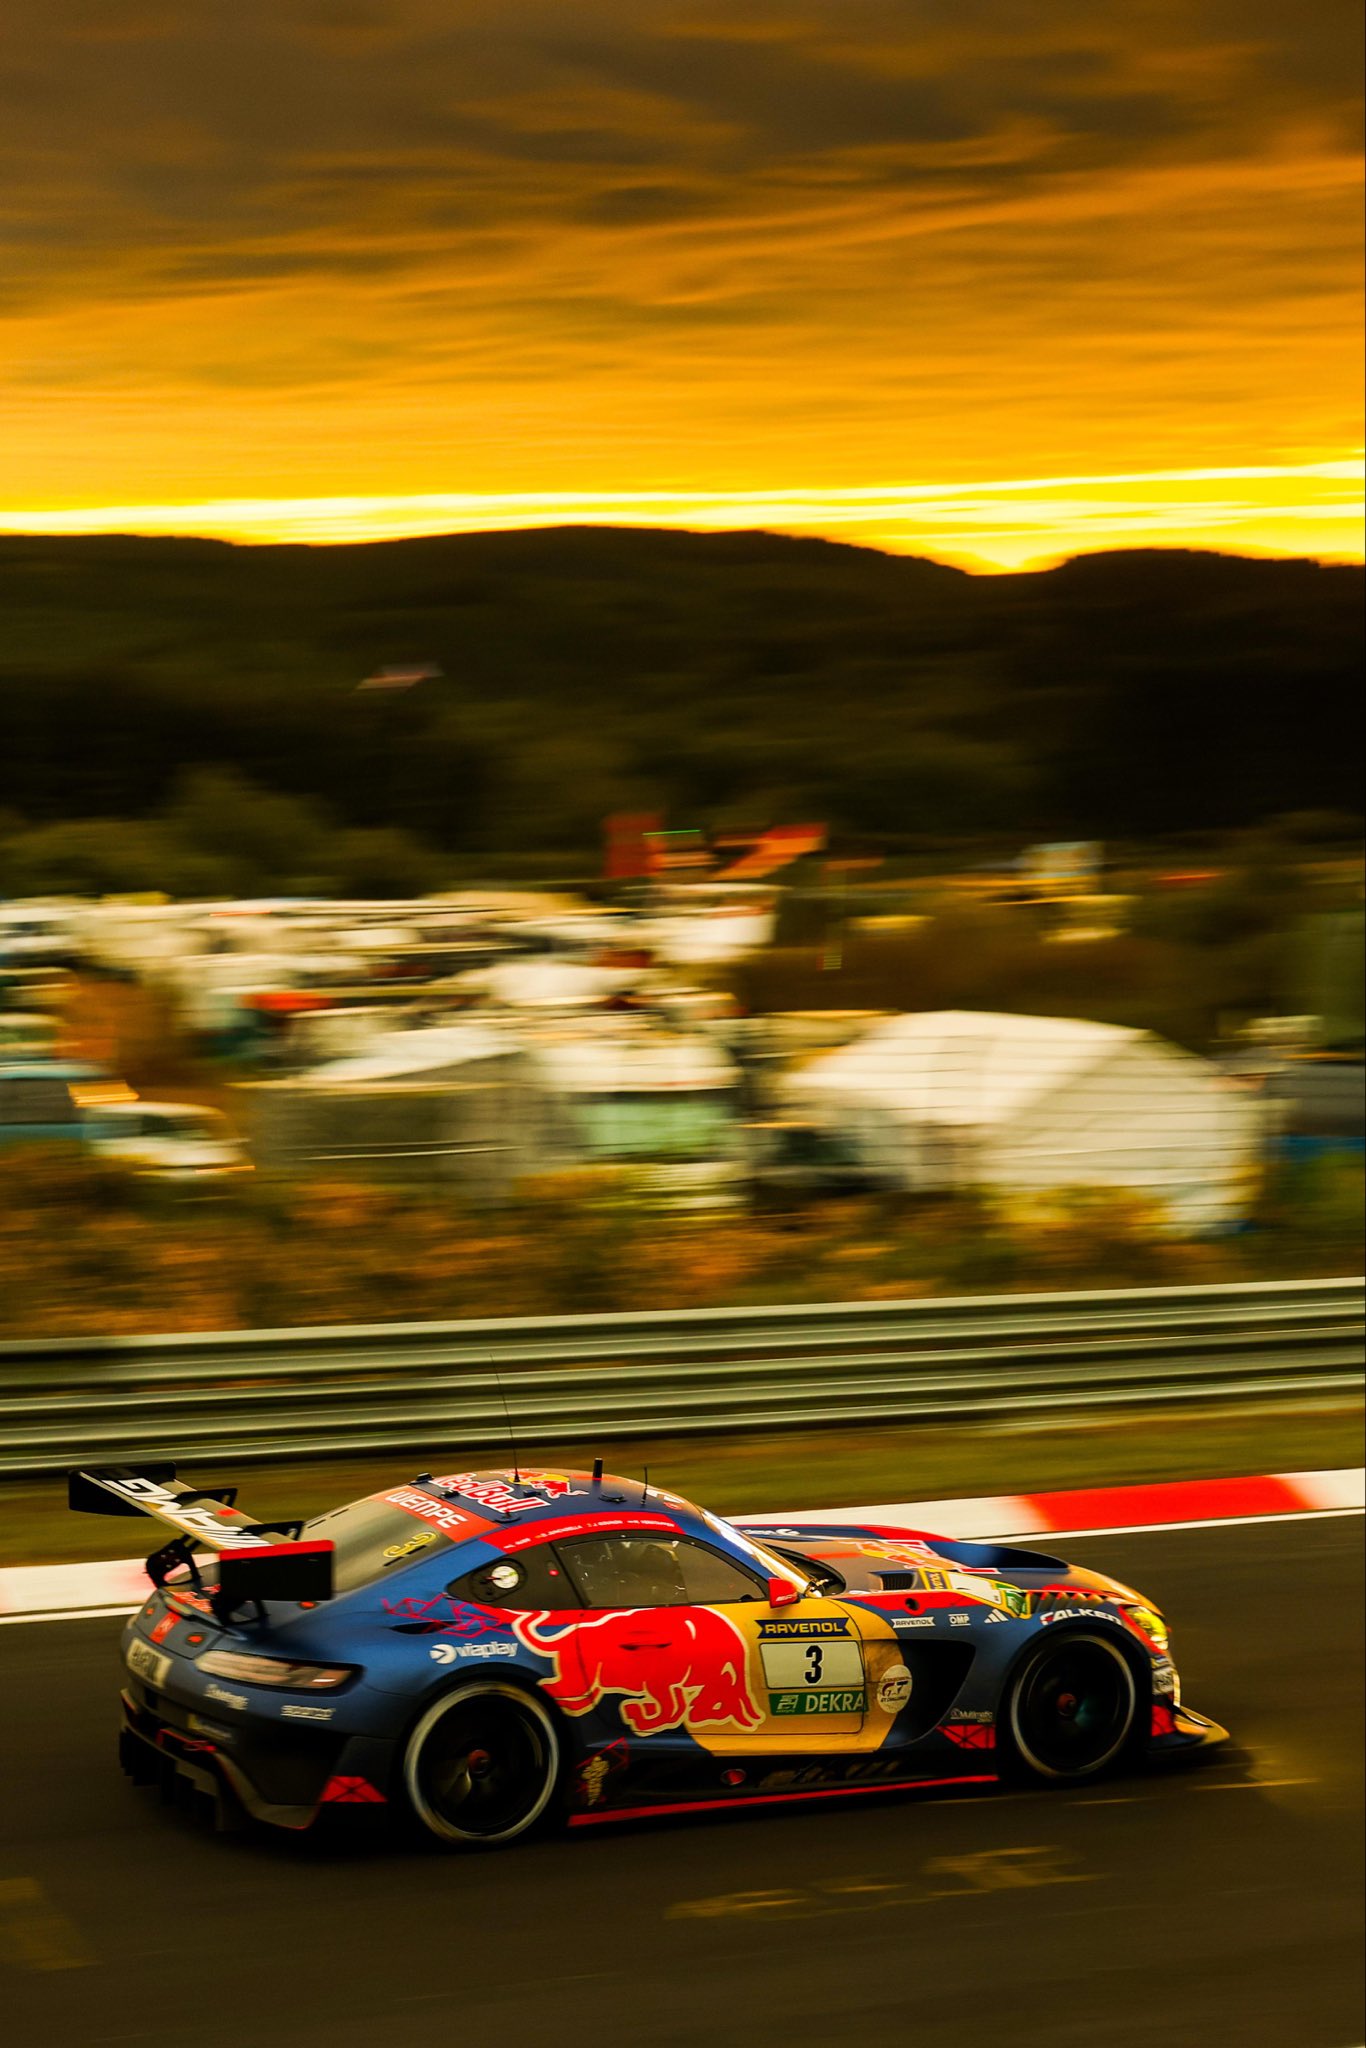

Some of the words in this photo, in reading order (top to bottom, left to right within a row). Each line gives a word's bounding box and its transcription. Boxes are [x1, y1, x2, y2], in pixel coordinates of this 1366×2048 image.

[385, 1490, 469, 1528] WEMPE
[949, 1615, 970, 1624] OMP
[1039, 1608, 1123, 1626] FALKEN
[764, 1622, 844, 1634] RAVENOL
[456, 1641, 518, 1658] viaplay
[804, 1644, 824, 1685] 3
[805, 1692, 864, 1713] DEKRA
